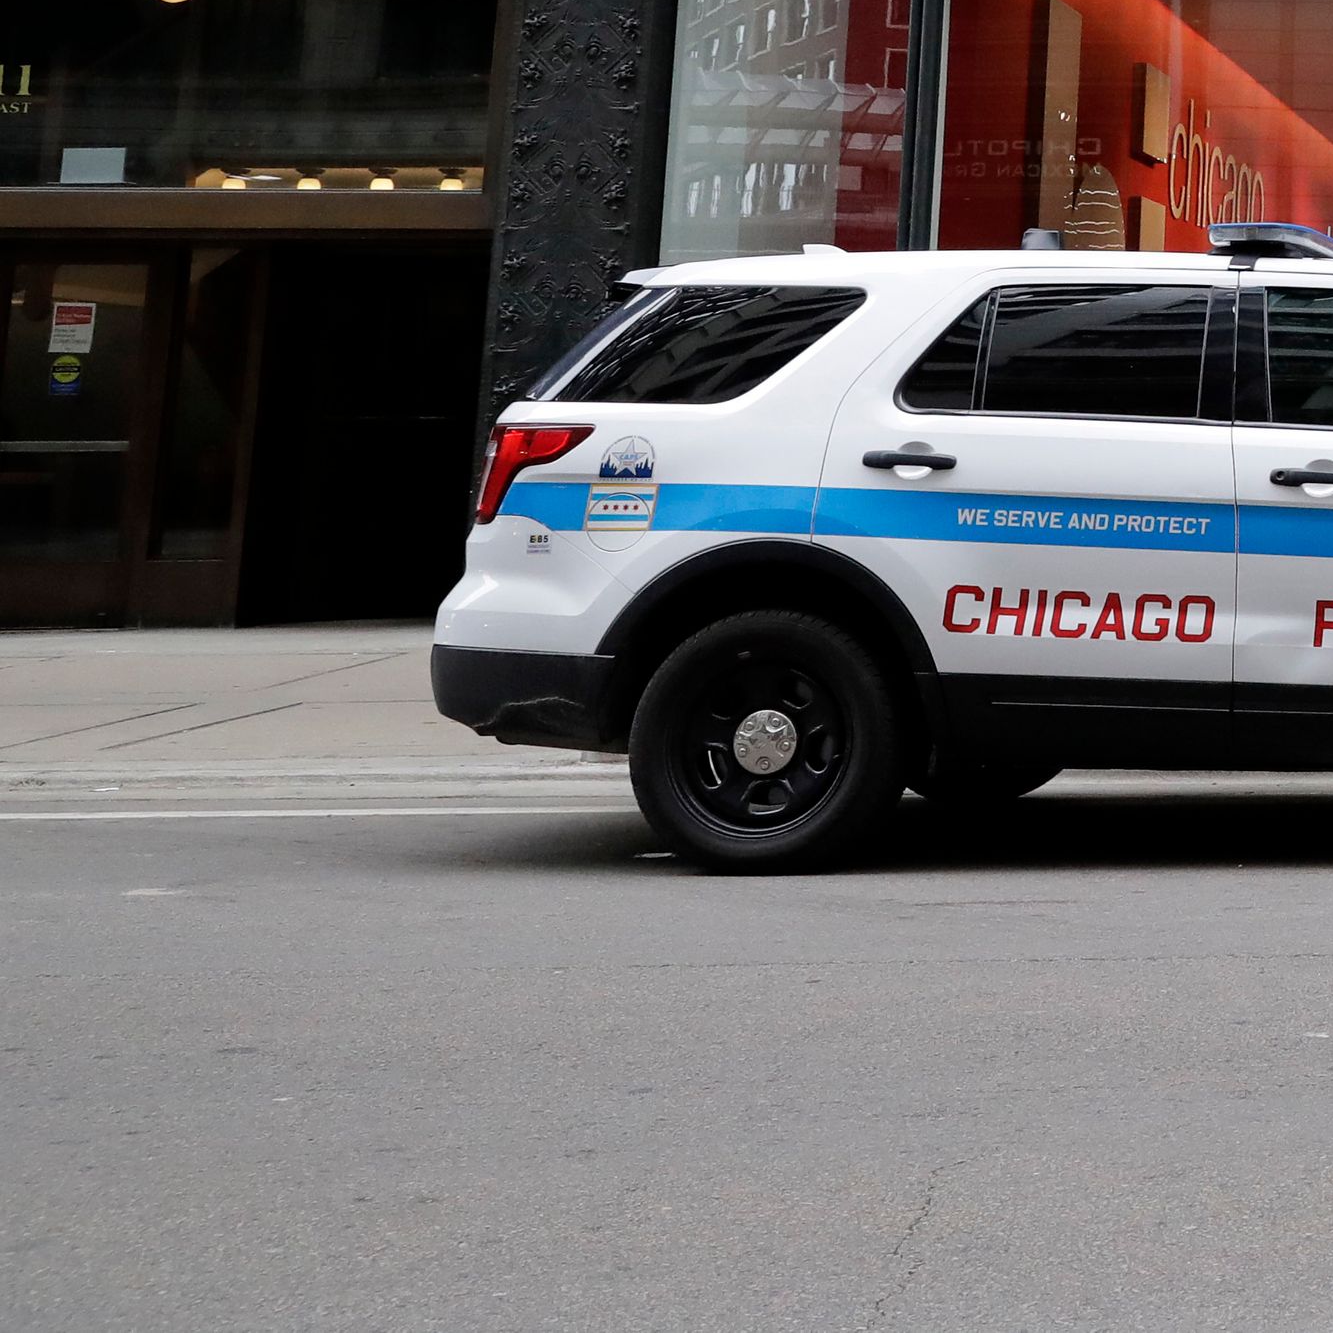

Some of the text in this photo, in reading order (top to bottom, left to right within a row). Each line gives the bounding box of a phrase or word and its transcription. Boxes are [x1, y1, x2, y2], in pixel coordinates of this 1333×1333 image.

[0, 102, 32, 114] AST
[957, 508, 1212, 536] WE SERVE AND PROTECT
[942, 584, 1216, 643] CHICAGO
